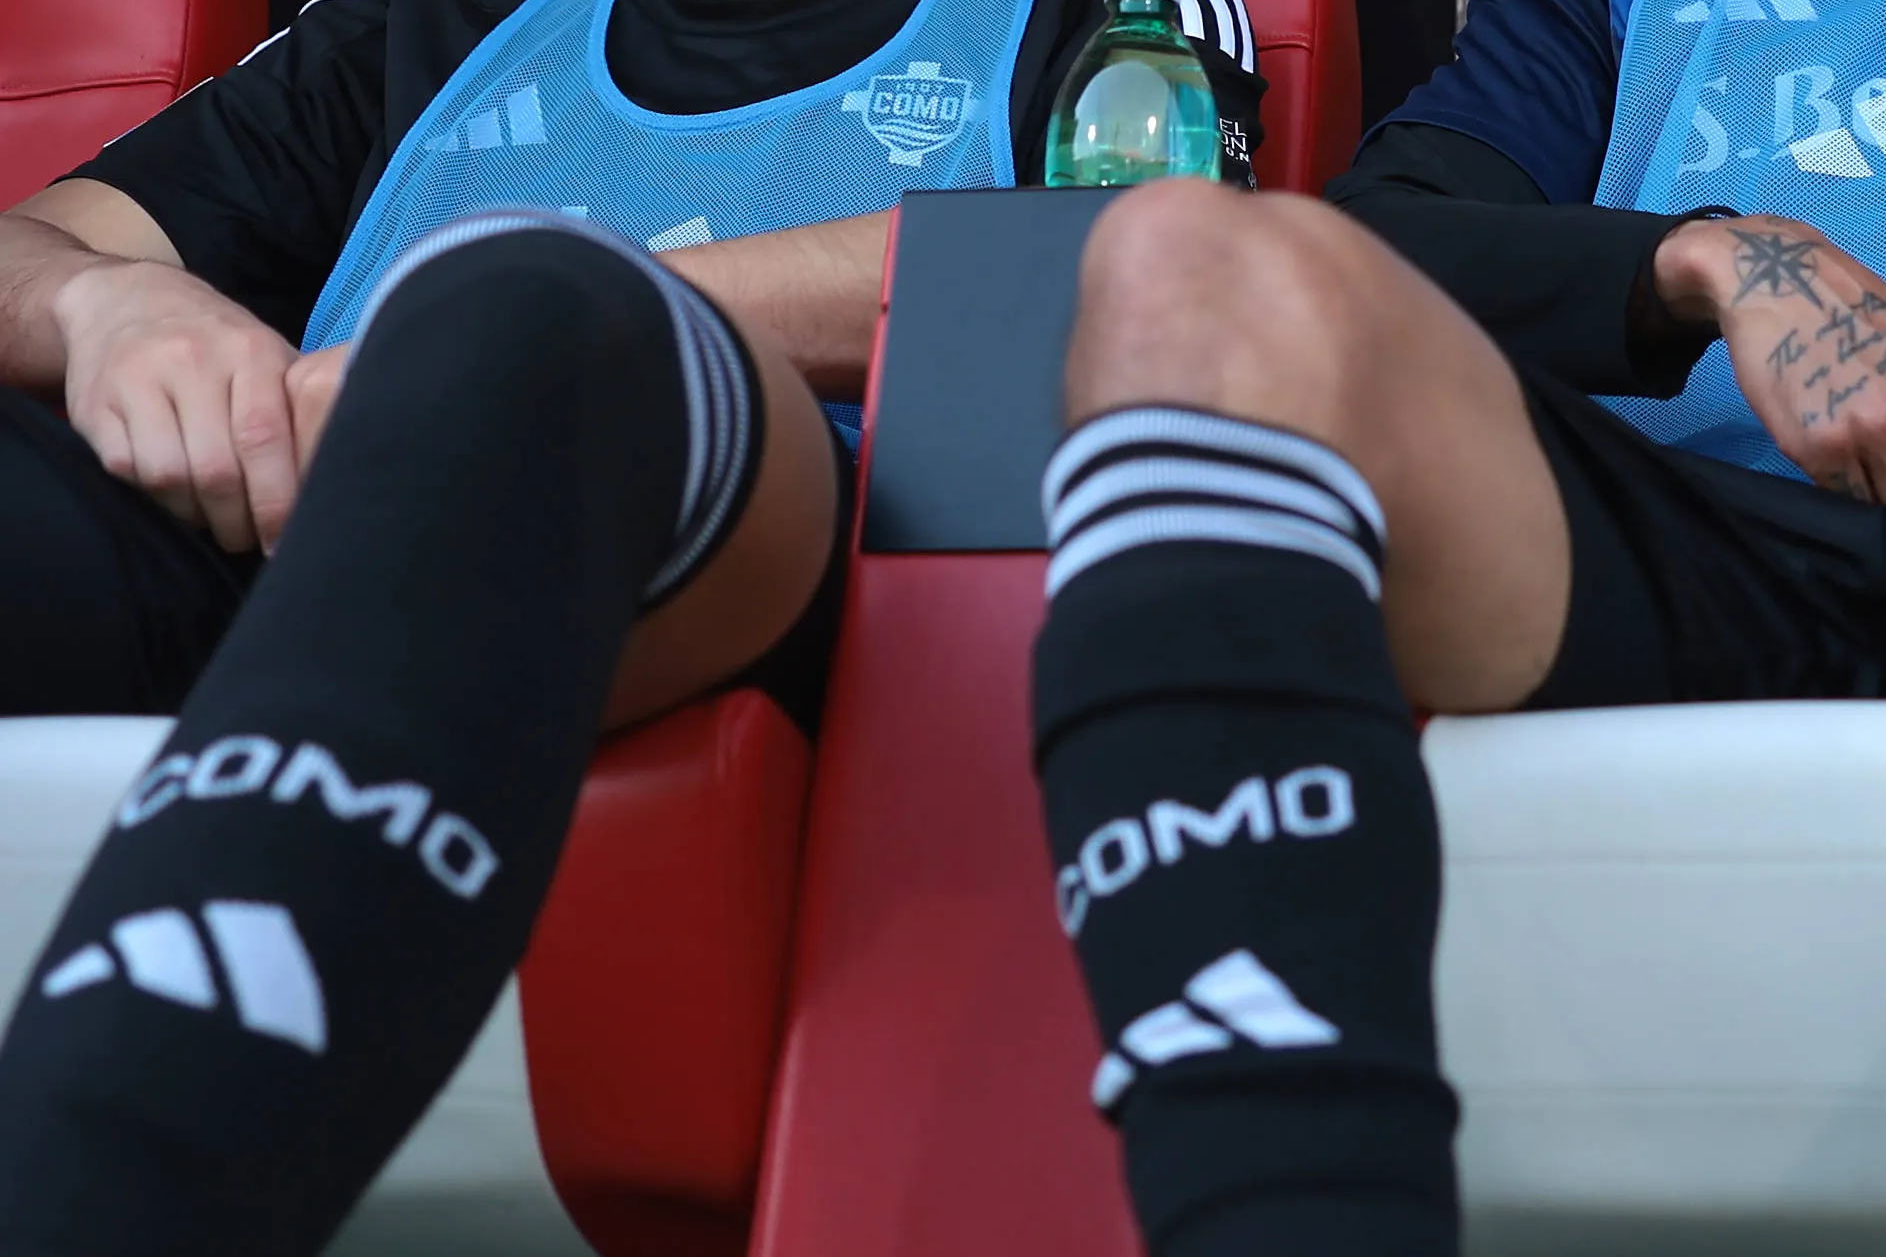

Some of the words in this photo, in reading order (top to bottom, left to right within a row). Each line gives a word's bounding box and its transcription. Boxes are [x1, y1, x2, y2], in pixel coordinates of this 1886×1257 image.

[873, 91, 960, 121] COMO
[115, 734, 500, 900] COMO
[1056, 763, 1357, 939] COMO
